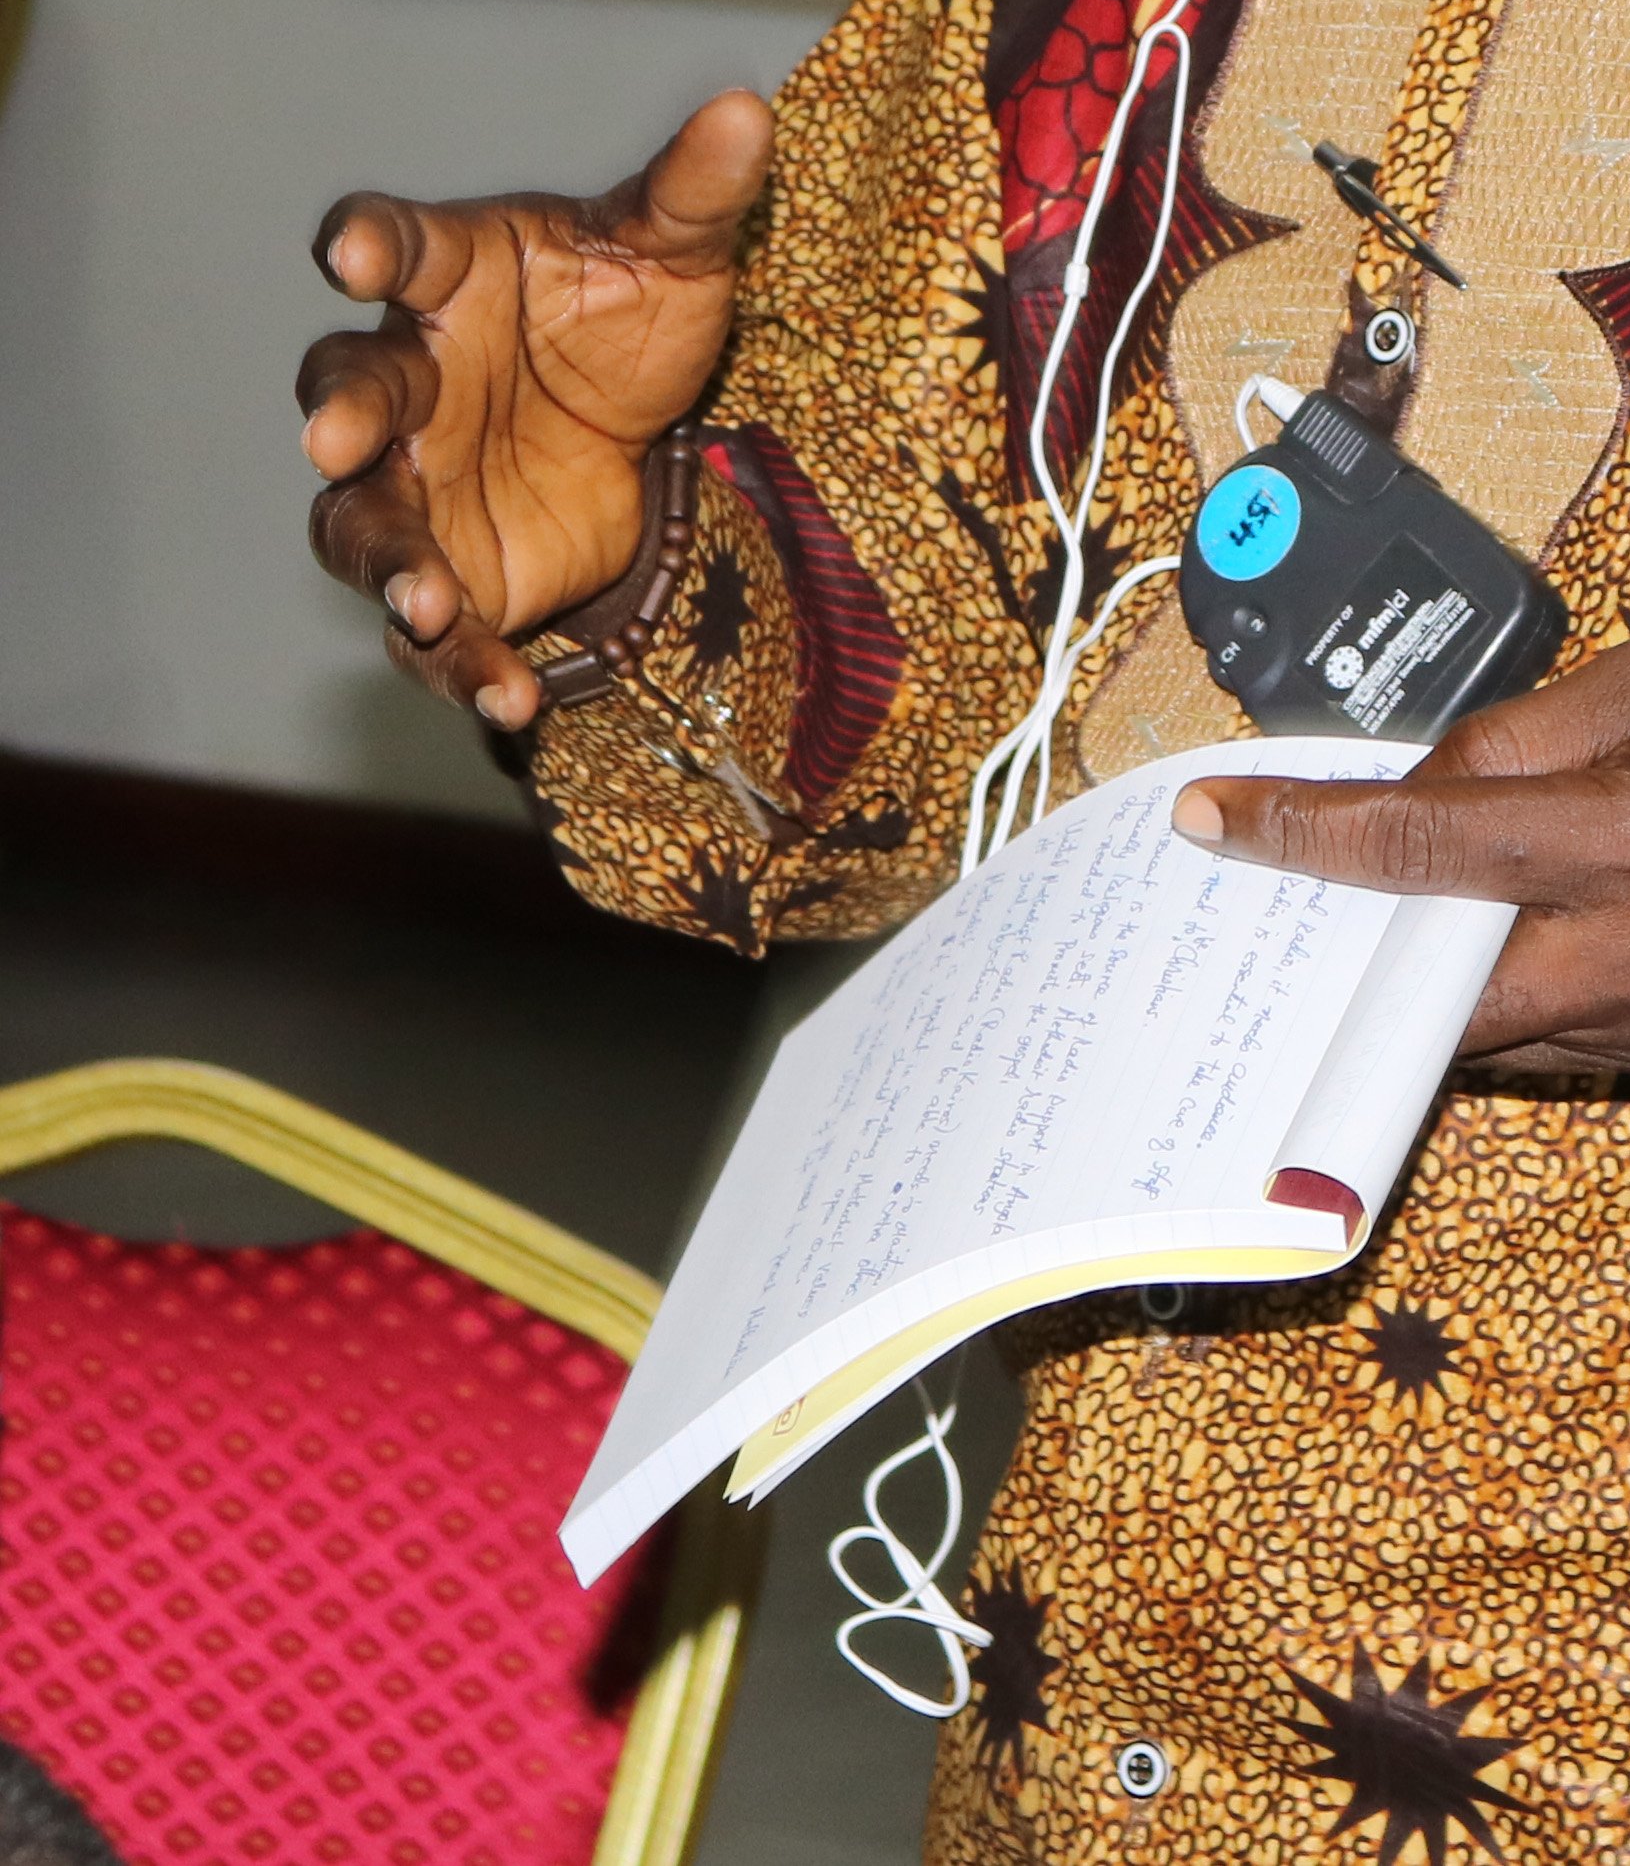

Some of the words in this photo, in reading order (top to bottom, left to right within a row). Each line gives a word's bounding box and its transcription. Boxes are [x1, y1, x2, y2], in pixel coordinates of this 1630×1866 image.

[1249, 617, 1265, 633] 2
[1303, 617, 1345, 666] PROPERTY
[1339, 603, 1355, 622] OF
[1220, 641, 1241, 664] CH
[1114, 921, 1140, 940] the
